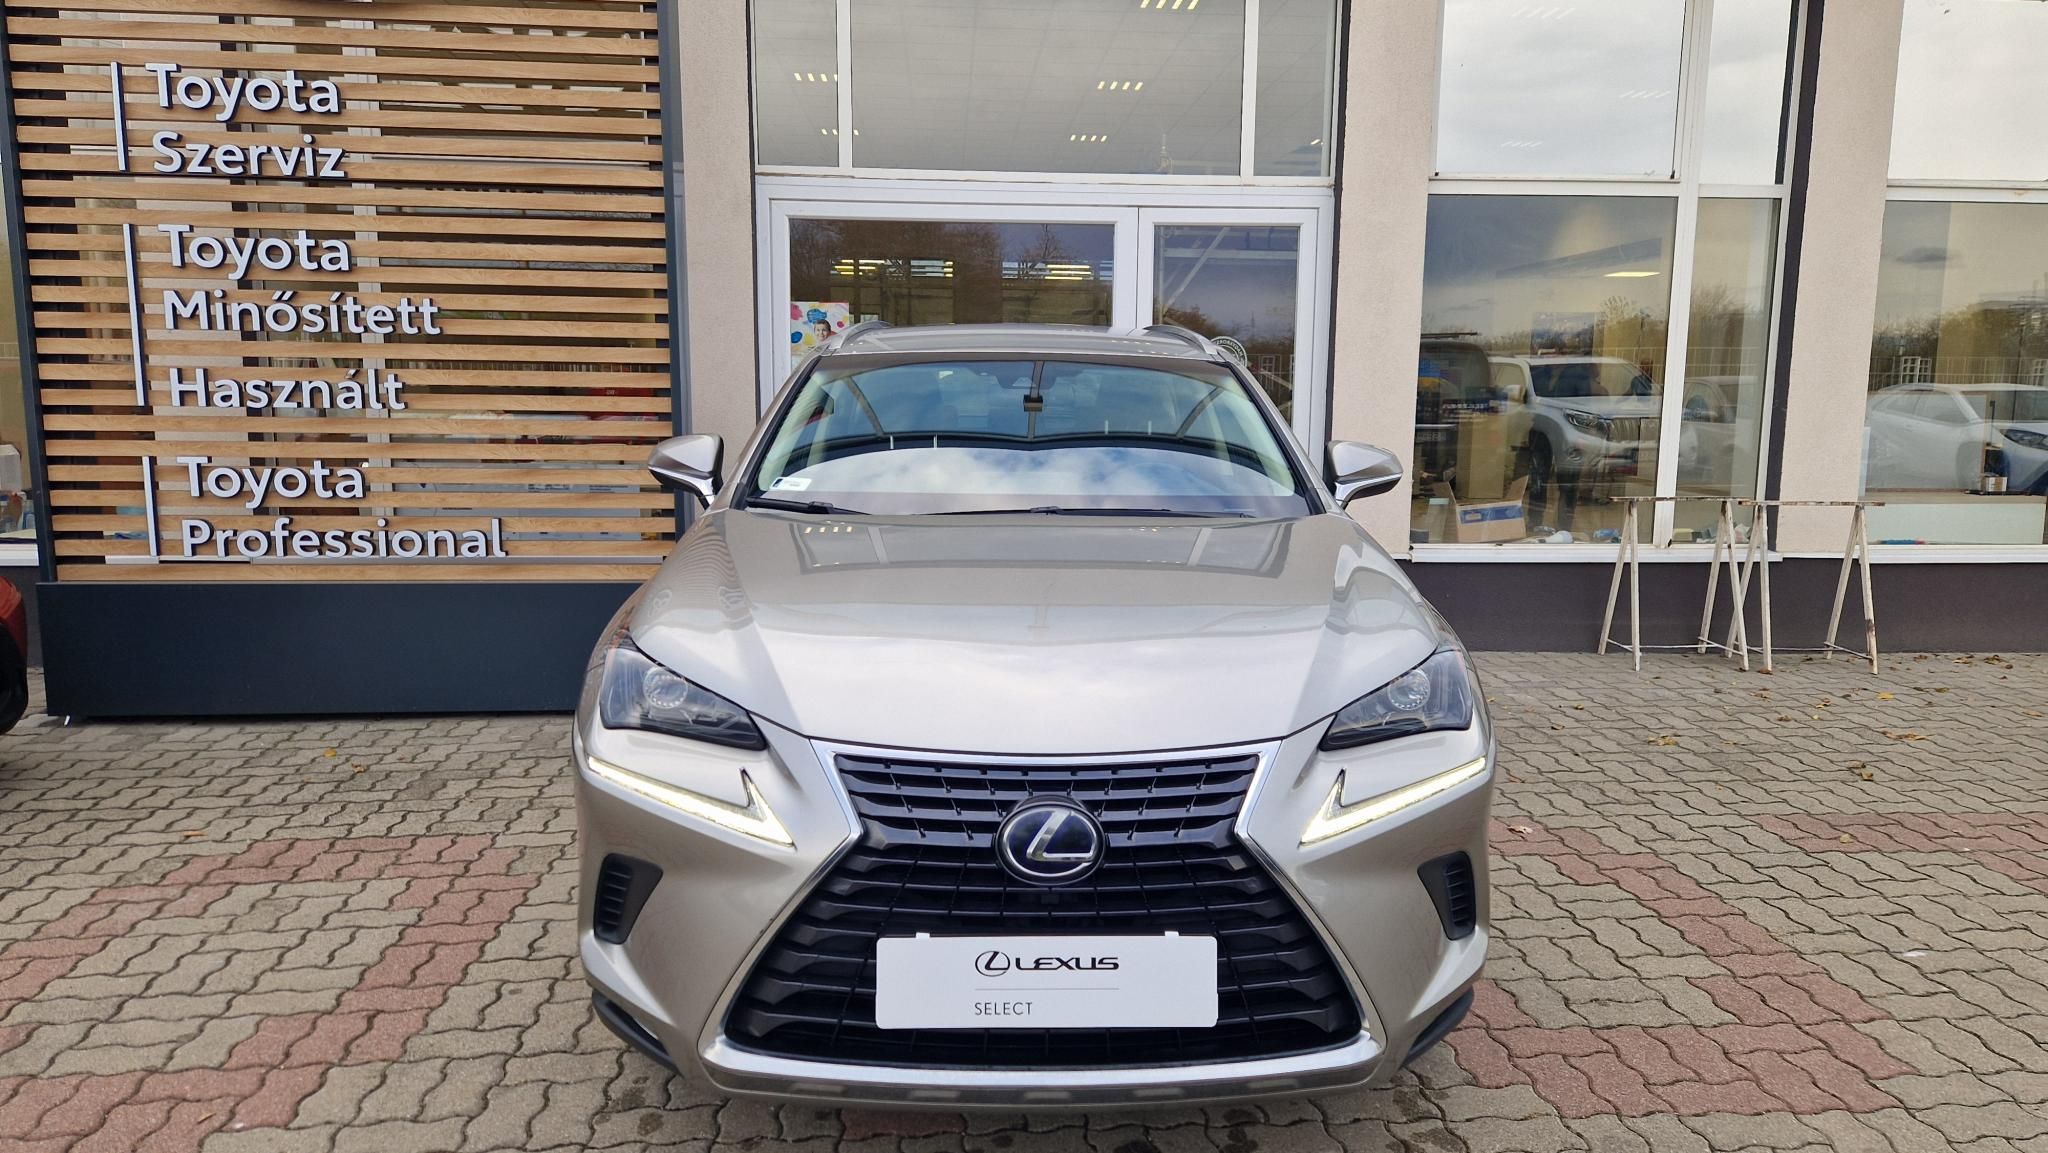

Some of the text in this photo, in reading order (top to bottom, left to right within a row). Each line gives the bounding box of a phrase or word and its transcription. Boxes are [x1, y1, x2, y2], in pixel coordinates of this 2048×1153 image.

[145, 62, 342, 122] Toyota
[152, 130, 347, 178] Szerviz
[158, 223, 352, 281] Toyota
[163, 289, 443, 336] Minősített
[169, 367, 407, 411] Használt
[176, 456, 367, 510] Toyota
[181, 516, 510, 558] Professional
[1015, 957, 1120, 970] LEXUS
[974, 1002, 1033, 1016] SELECT
